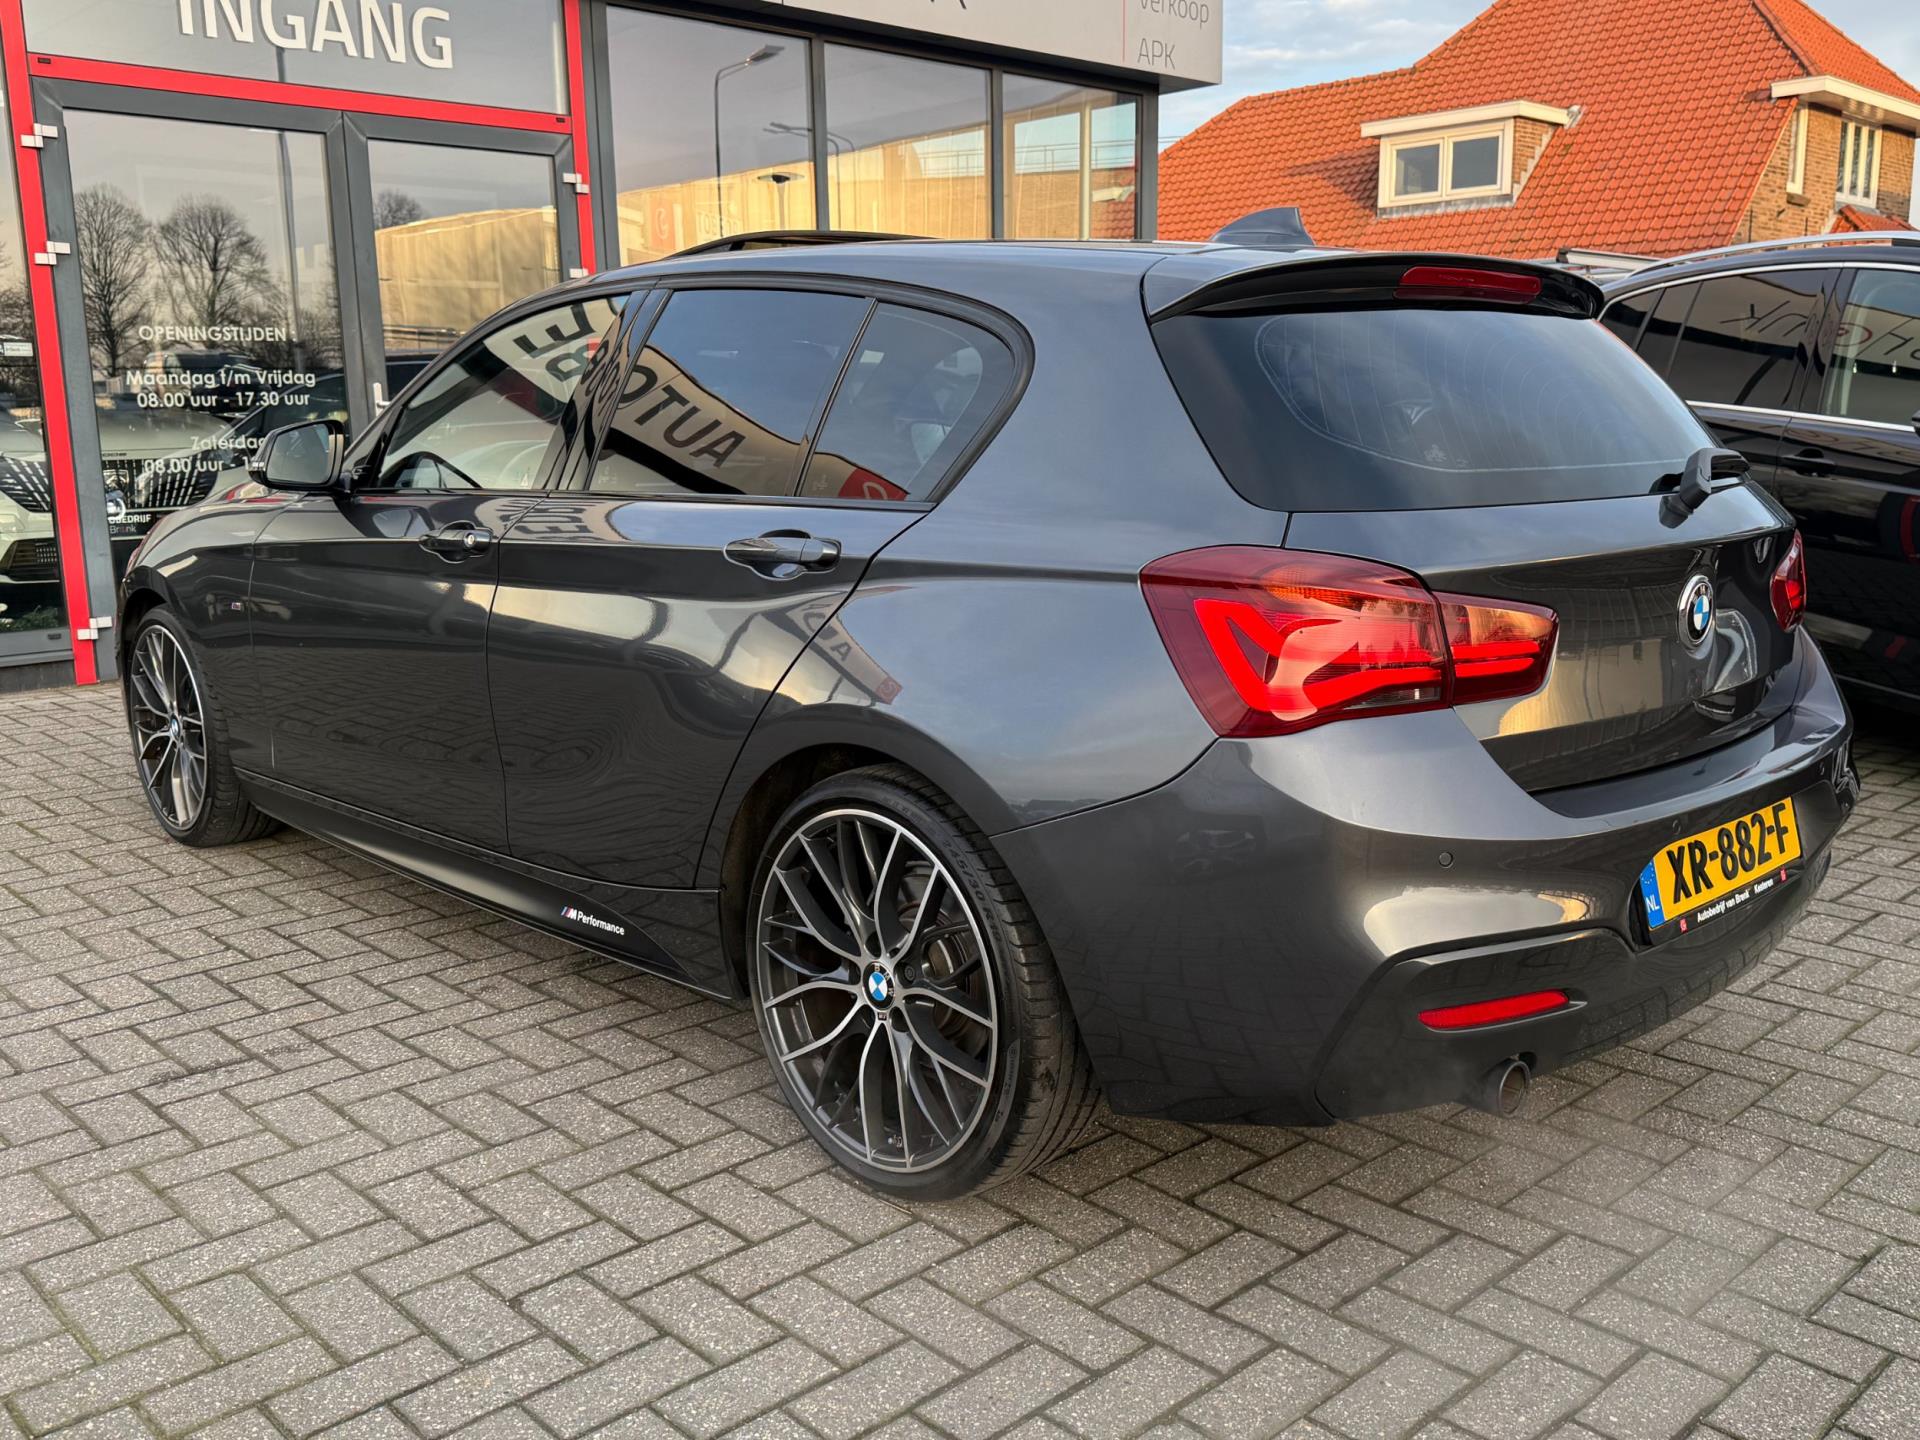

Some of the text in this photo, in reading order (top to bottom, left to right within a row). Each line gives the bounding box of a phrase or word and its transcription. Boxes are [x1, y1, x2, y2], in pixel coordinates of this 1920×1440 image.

[179, 0, 454, 69] INGANG
[1137, 37, 1176, 70] APK
[138, 325, 287, 342] OPENINGSTIJDEN
[126, 370, 316, 388] Maandag t/m Vrijdag
[137, 392, 185, 408] 08.00
[190, 394, 218, 407] uur
[235, 391, 279, 406] 17.30
[284, 393, 311, 406] uur
[144, 458, 192, 474] 08.00
[197, 460, 224, 472] uur
[1666, 802, 1789, 904] XR-882-F
[1645, 896, 1660, 912] NL
[577, 911, 625, 935] Performance
